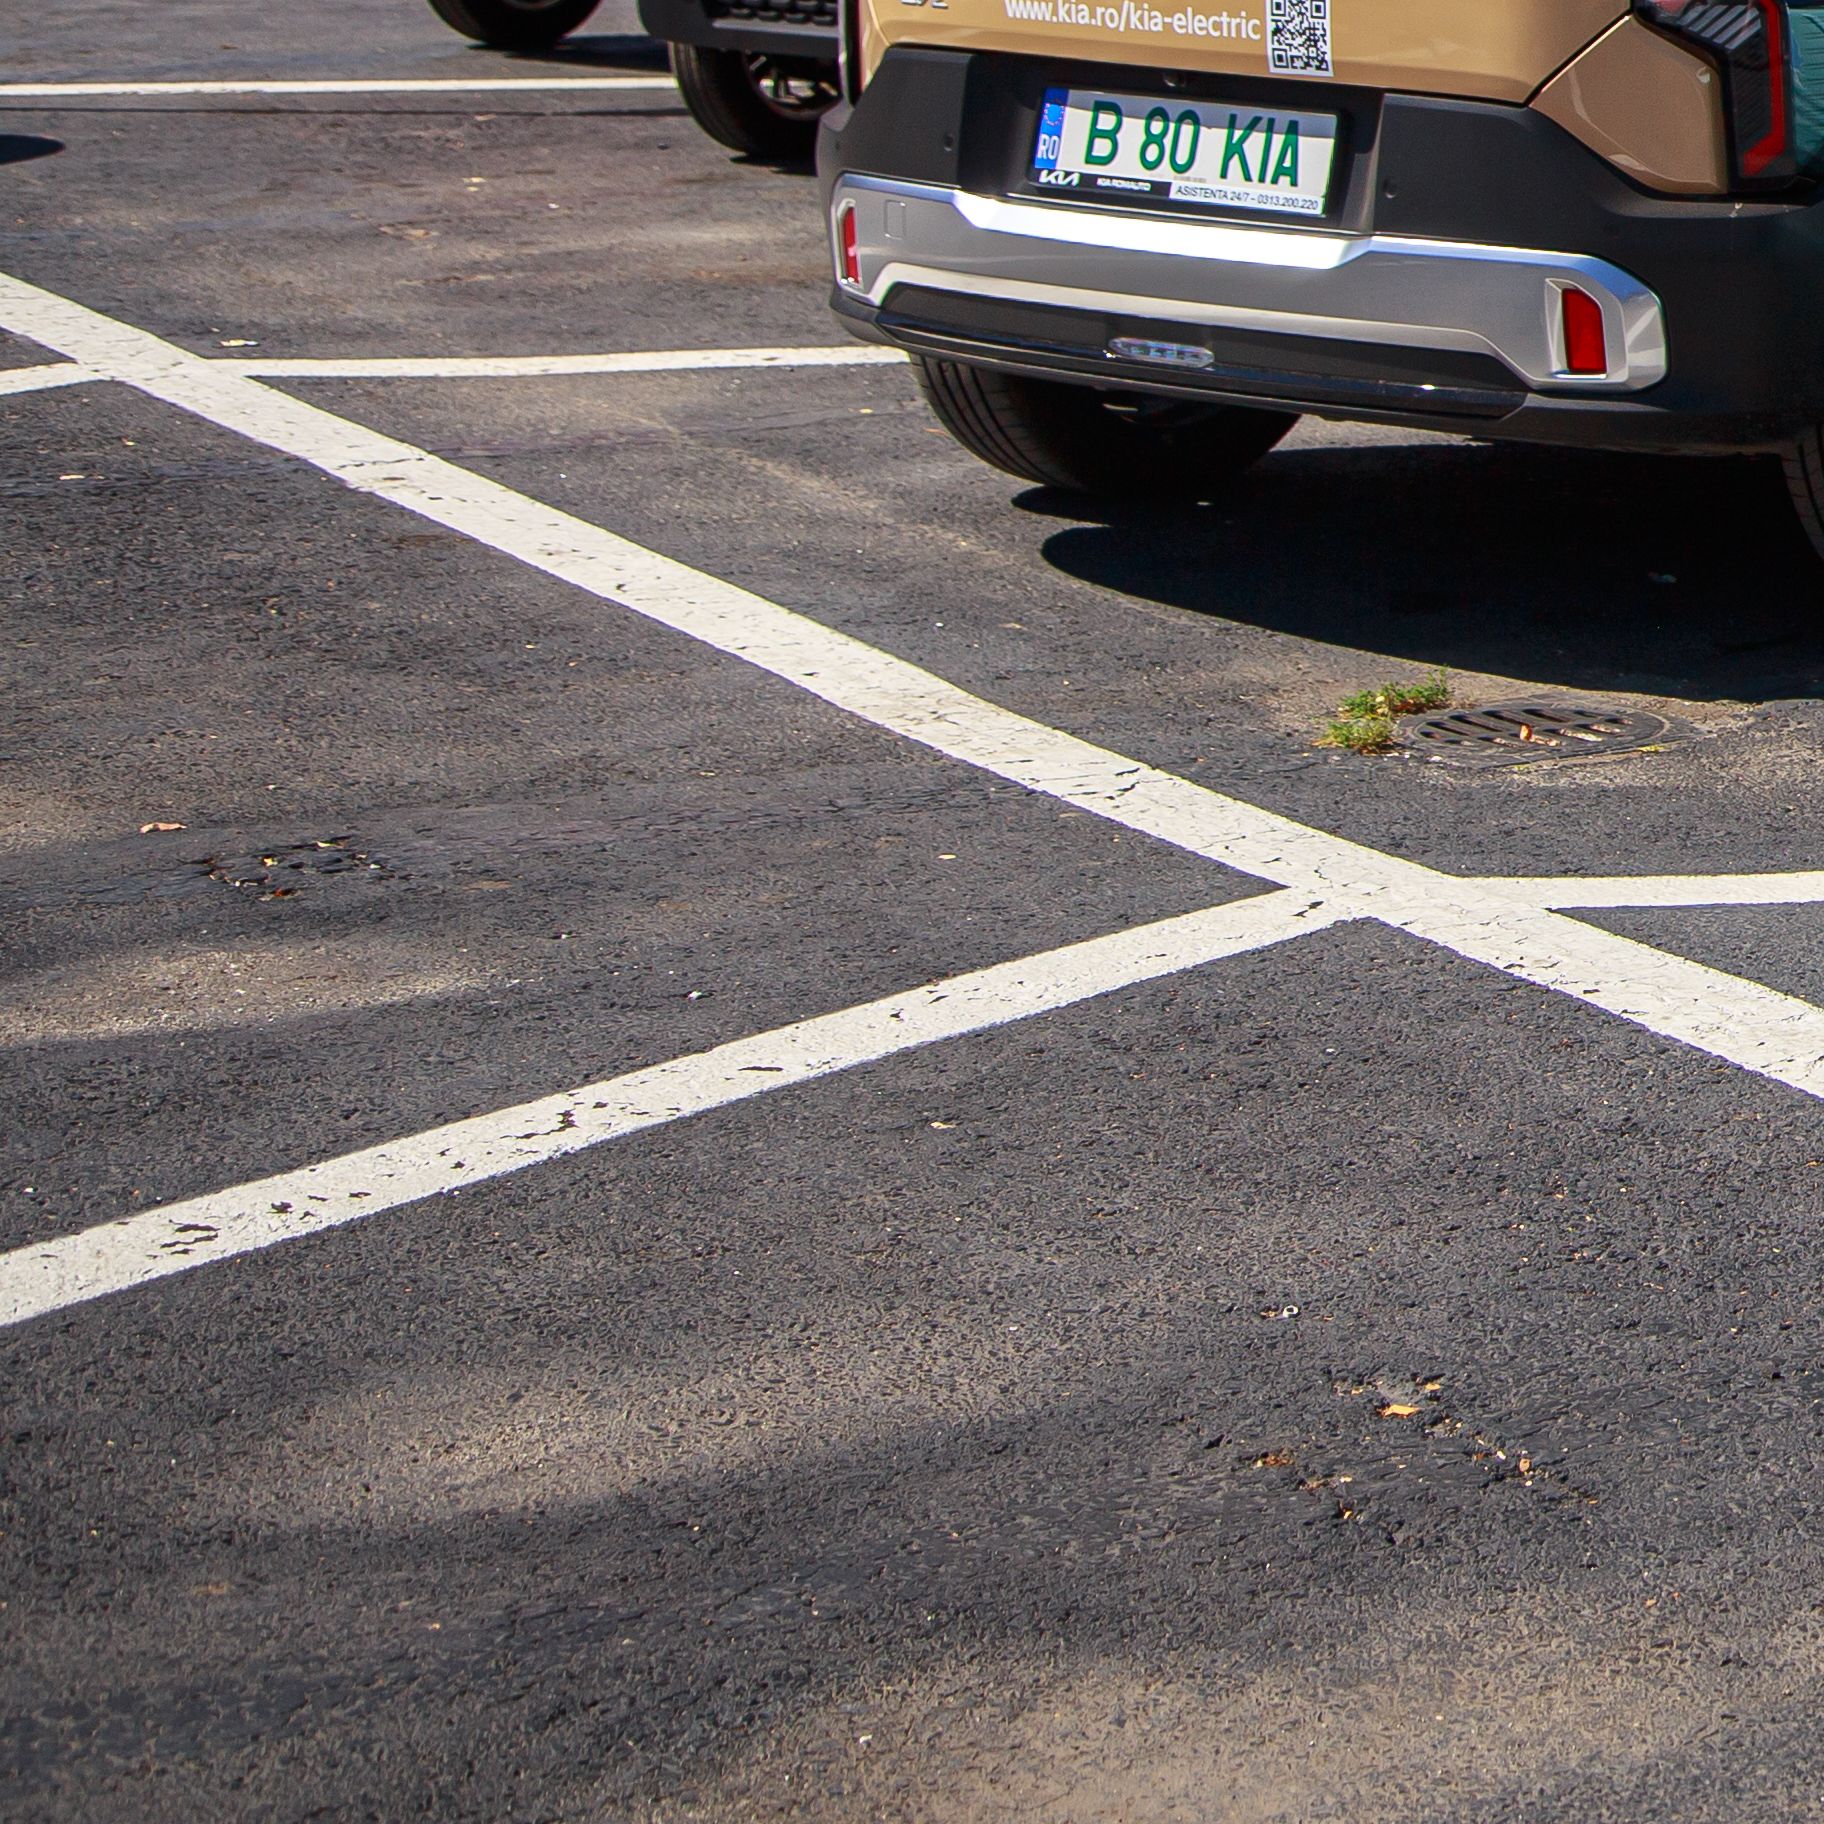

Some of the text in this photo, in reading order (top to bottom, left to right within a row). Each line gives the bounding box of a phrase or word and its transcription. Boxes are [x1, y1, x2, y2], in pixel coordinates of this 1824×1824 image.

[1039, 100, 1299, 187] RO B 80 KIA
[1175, 184, 1228, 201] ASISTENTA
[1230, 190, 1249, 203] 24/7
